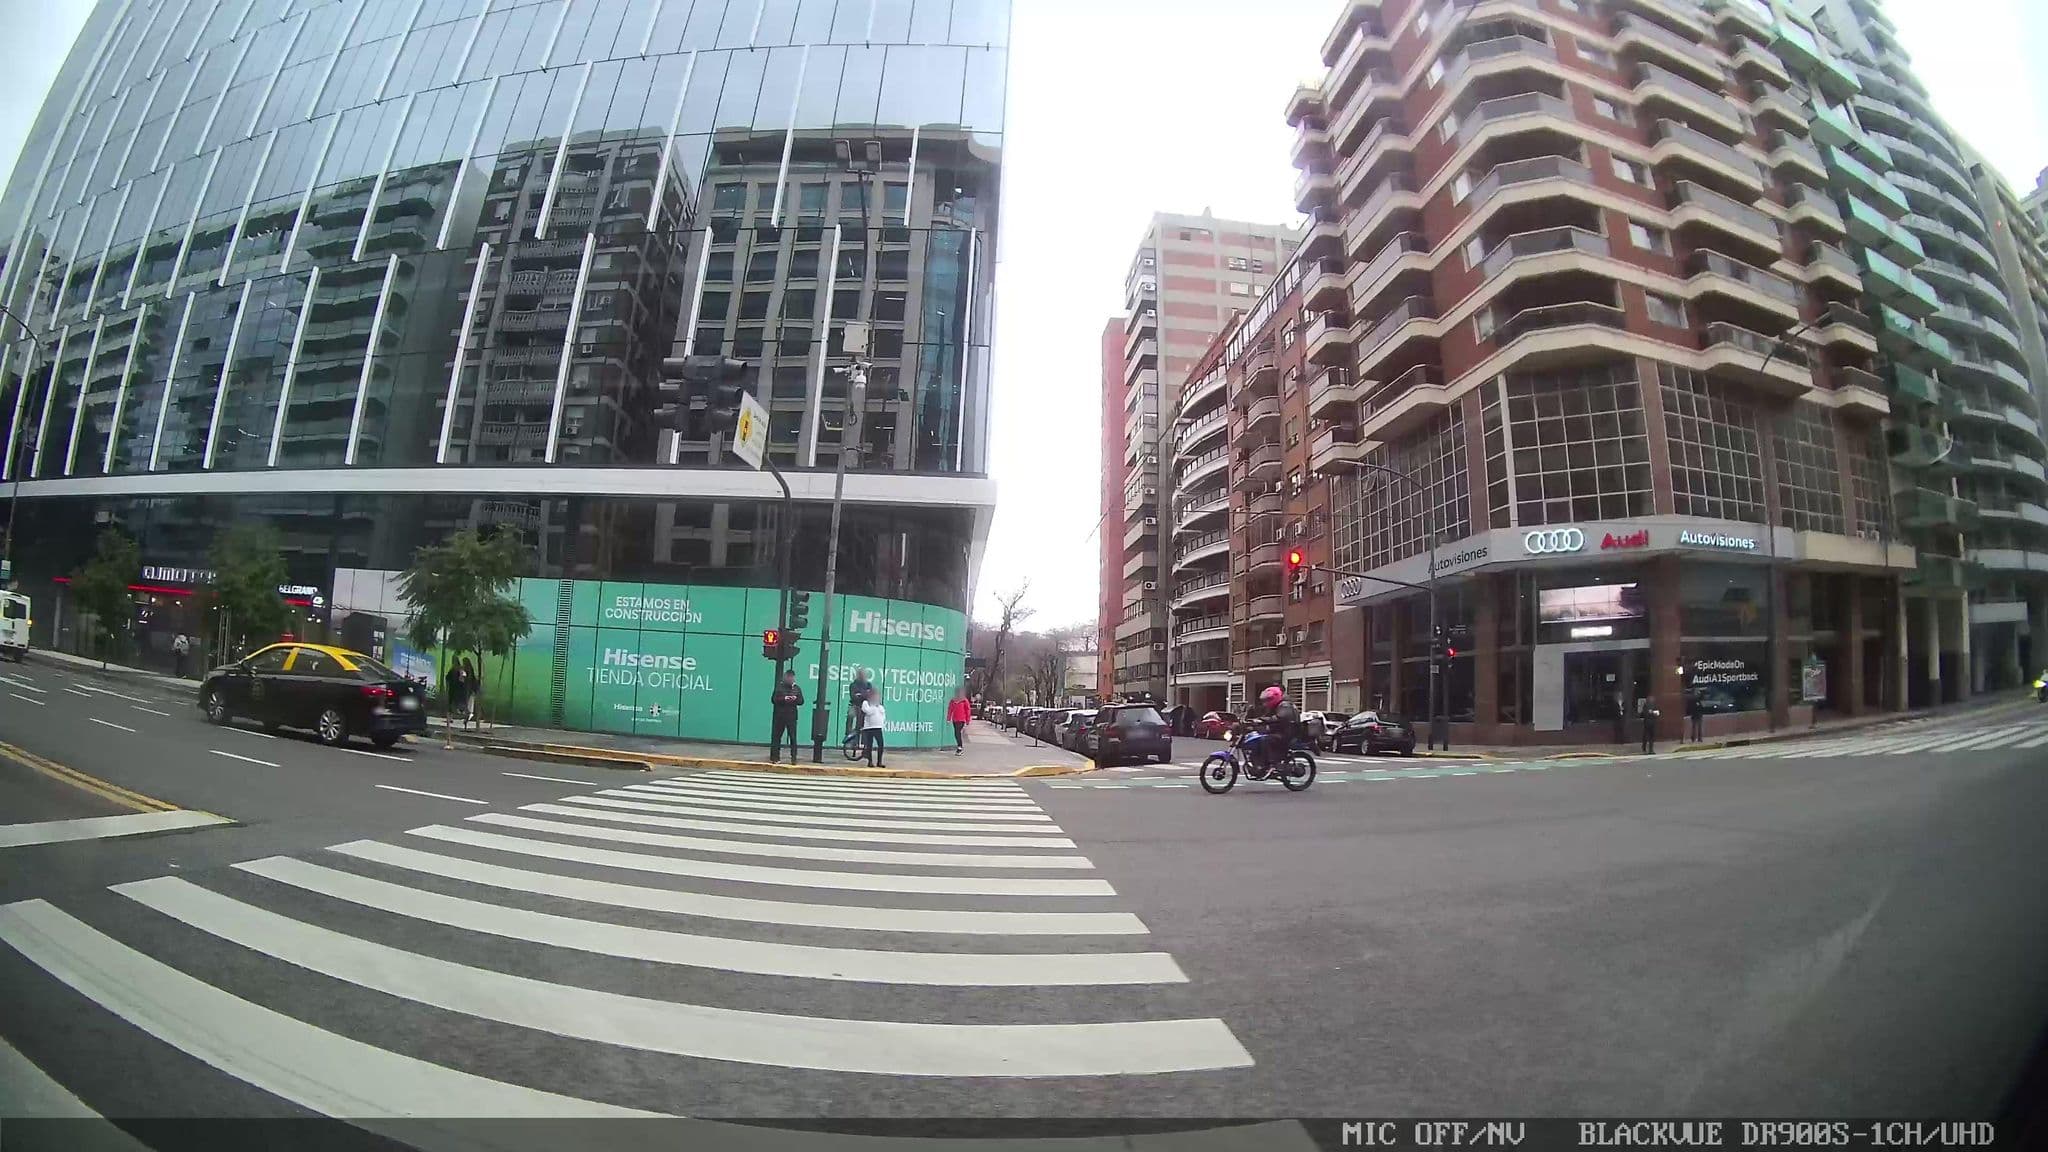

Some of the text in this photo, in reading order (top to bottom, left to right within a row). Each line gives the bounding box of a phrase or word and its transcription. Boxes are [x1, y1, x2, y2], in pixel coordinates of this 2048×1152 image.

[1600, 529, 1649, 550] Audi
[1680, 530, 1756, 550] Autovisiones
[616, 596, 690, 612] ESTAMOS EN
[849, 610, 945, 642] Hisense
[603, 648, 697, 671] Hisense
[586, 667, 712, 692] TIENDA OFICIAL
[809, 662, 876, 684] DSEÑO
[879, 667, 890, 684] Y
[884, 685, 945, 703] TU HOGAR
